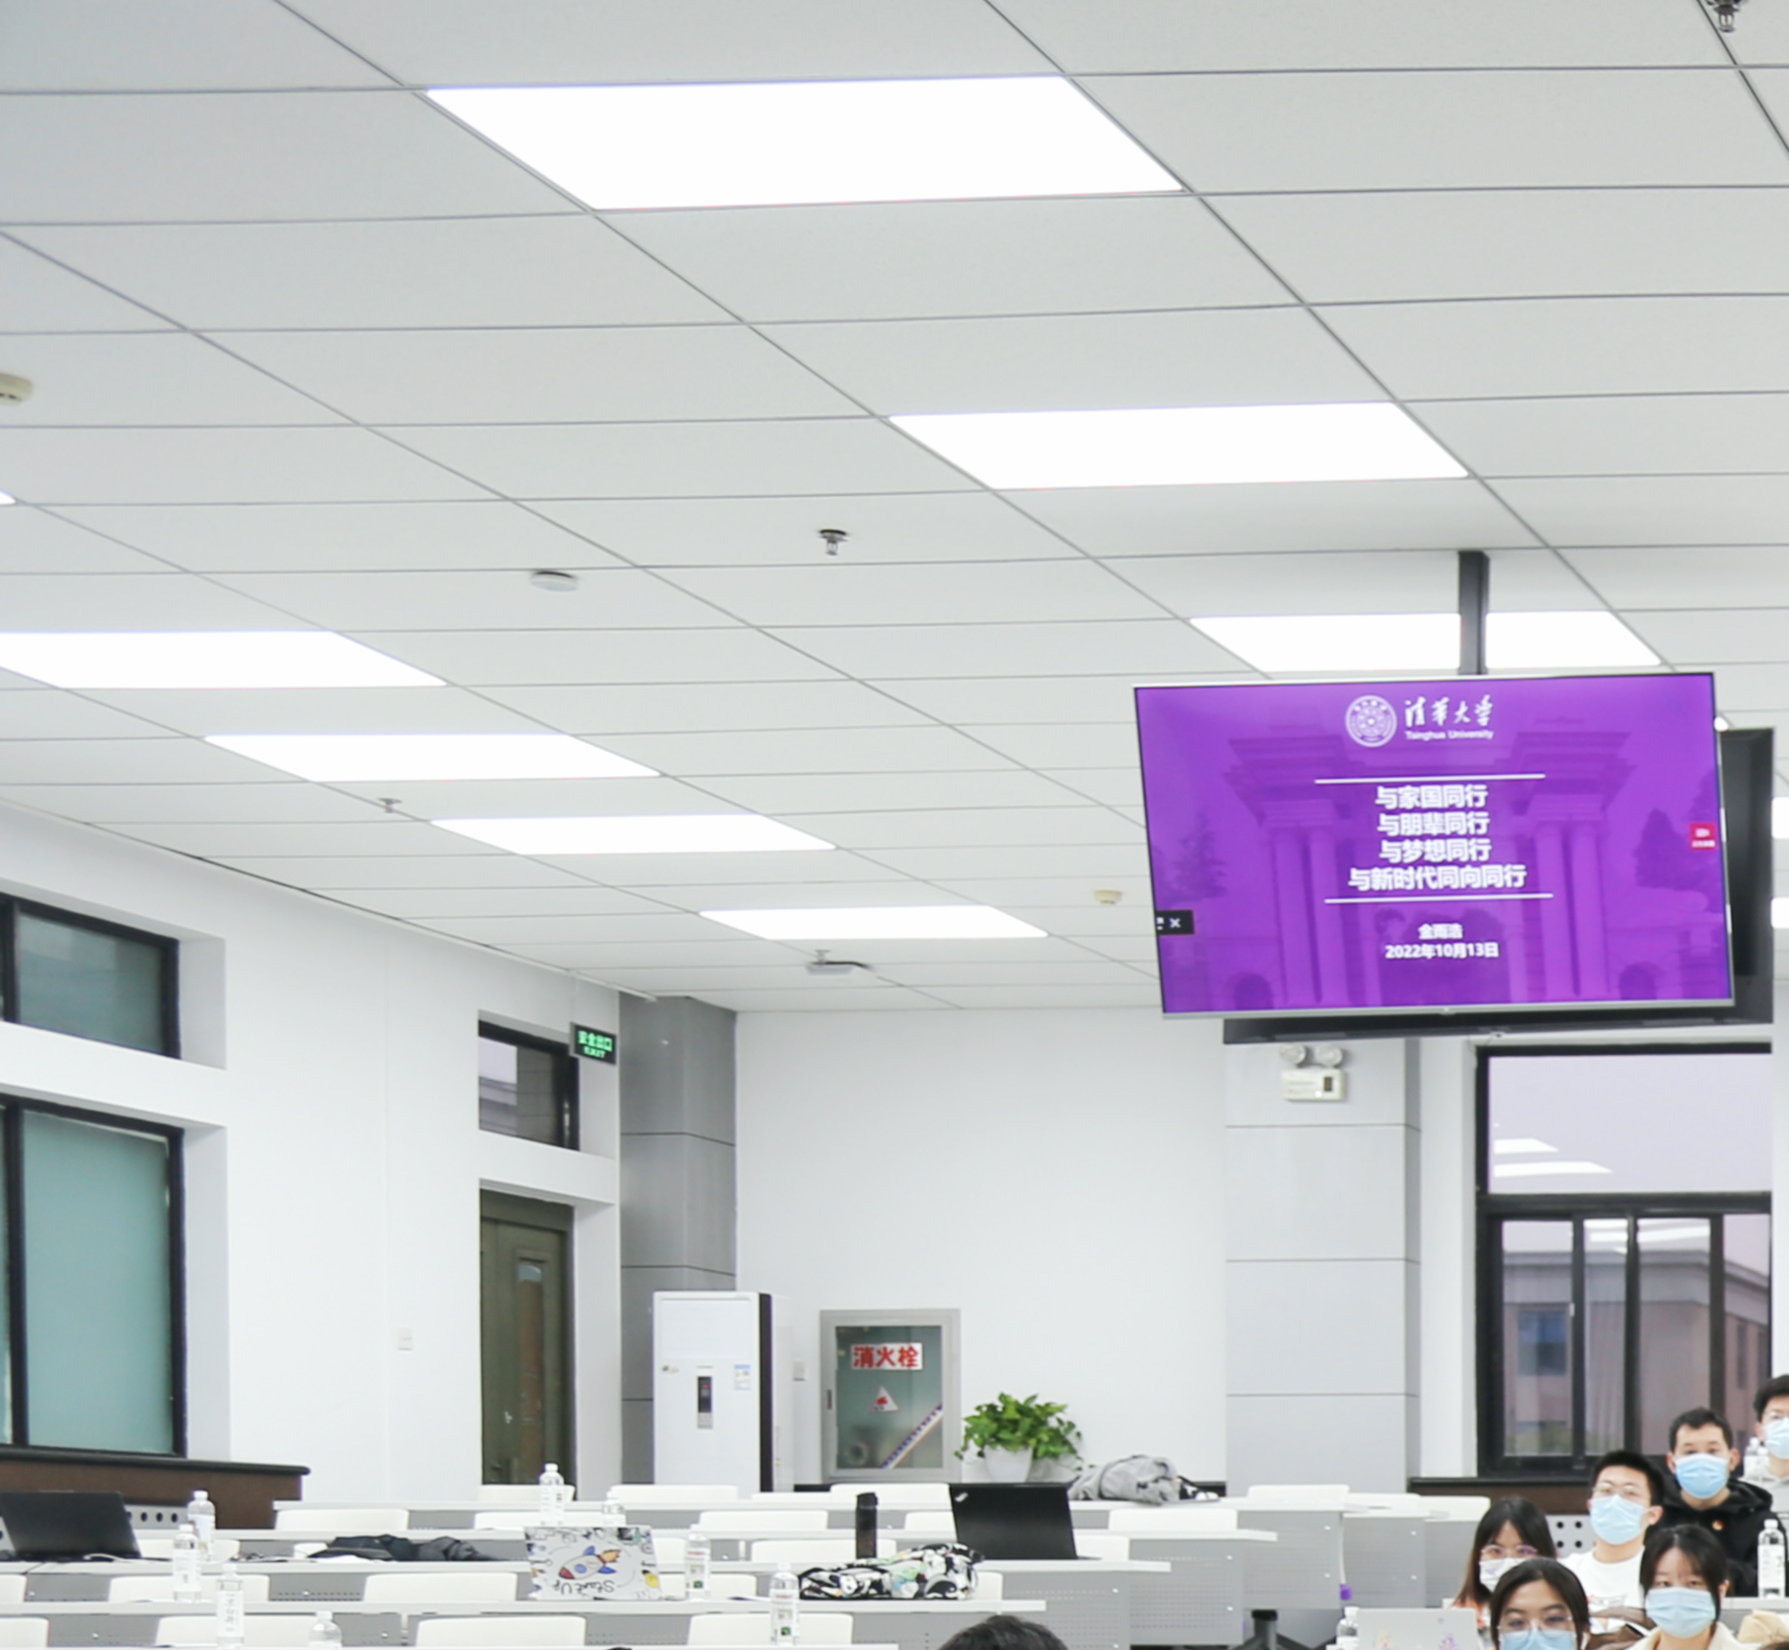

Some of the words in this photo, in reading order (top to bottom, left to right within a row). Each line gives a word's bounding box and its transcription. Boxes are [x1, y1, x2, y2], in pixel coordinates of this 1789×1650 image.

[1404, 730, 1447, 742] Tsinghua
[1448, 729, 1495, 741] University
[1375, 784, 1488, 809] 与家国同行
[1377, 811, 1490, 837] 与朋辈同行
[1379, 838, 1491, 863] 与梦想同行
[1348, 864, 1527, 891] 与新时代同向同行
[1384, 942, 1499, 959] 2022年10月13日
[578, 1030, 612, 1052] 安全出口
[583, 1045, 606, 1058] EXIT
[853, 1346, 919, 1369] 消火栓
